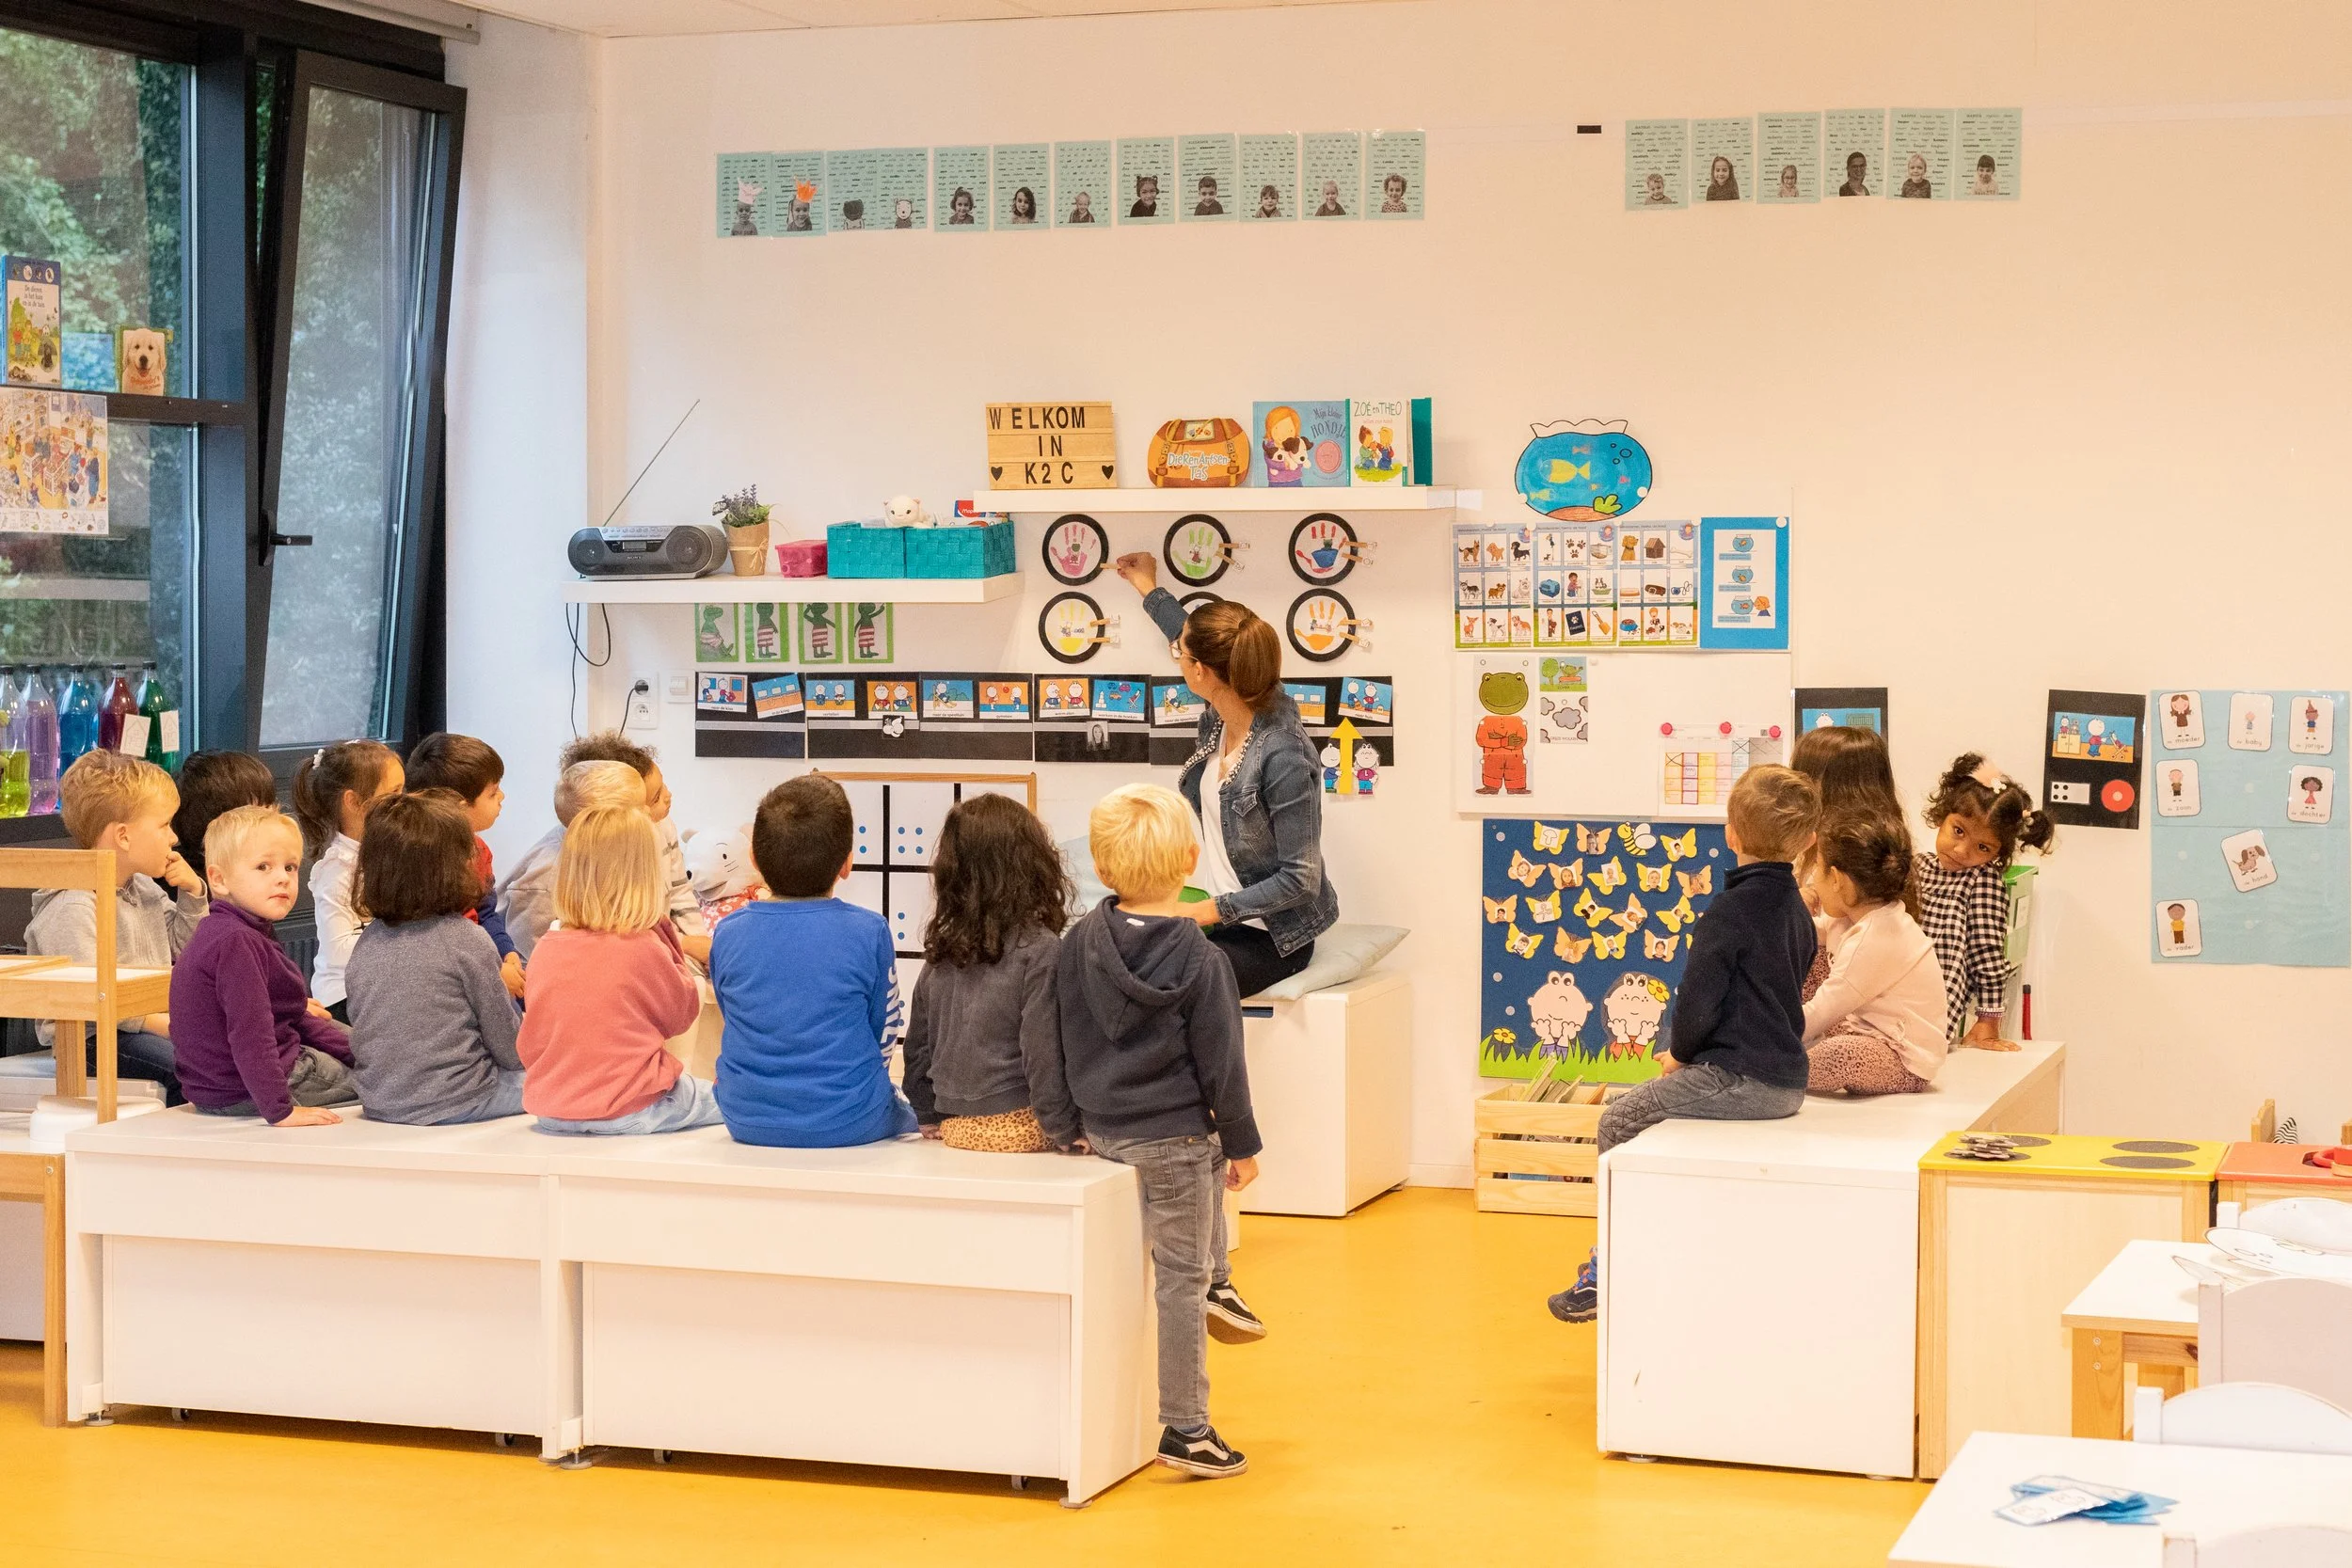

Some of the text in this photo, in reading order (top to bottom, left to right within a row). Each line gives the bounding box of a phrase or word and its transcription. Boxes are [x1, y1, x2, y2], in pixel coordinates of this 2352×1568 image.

[1313, 405, 1343, 420] Mijn kleine
[1354, 402, 1372, 417] ZOÉ
[1378, 401, 1403, 416] THEO
[989, 406, 1086, 430] WELKOM
[1039, 436, 1063, 457] IN
[2251, 873, 2268, 882] hond
